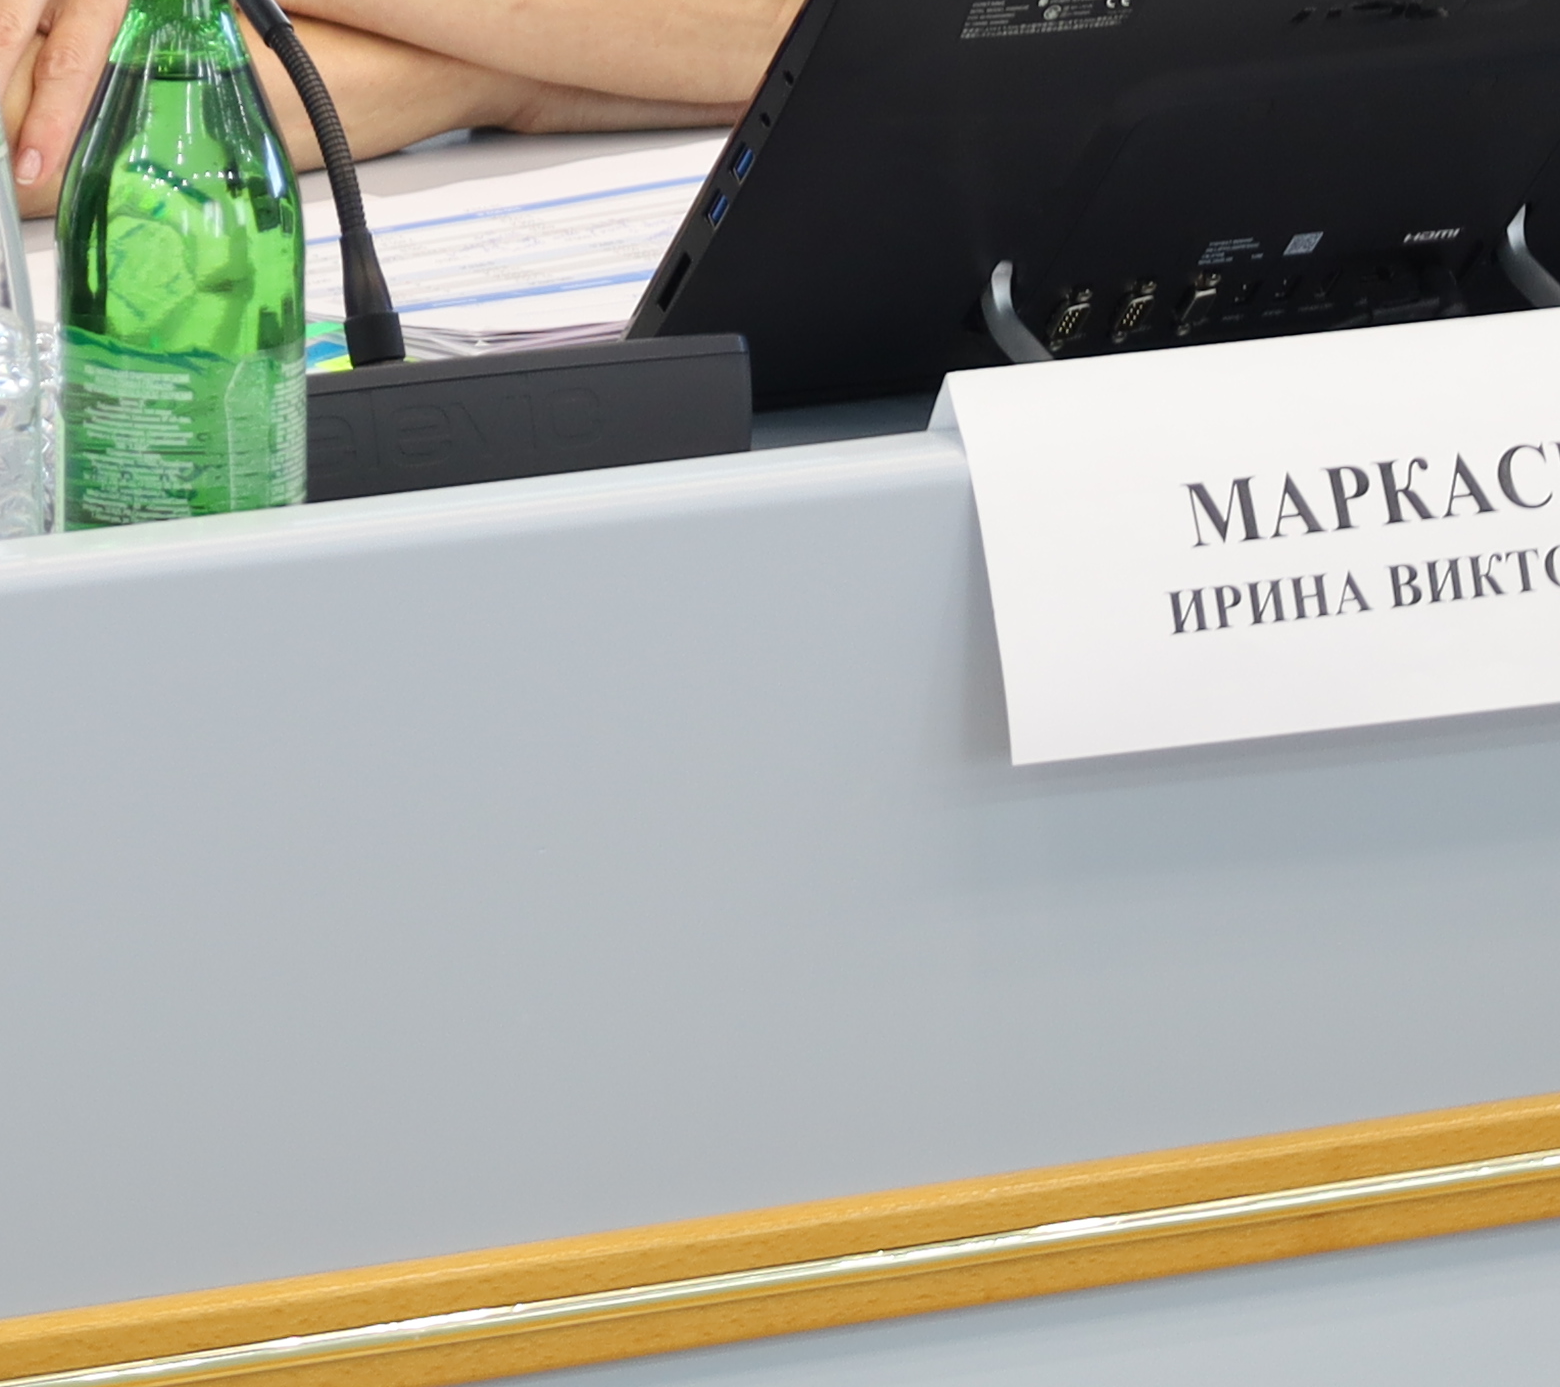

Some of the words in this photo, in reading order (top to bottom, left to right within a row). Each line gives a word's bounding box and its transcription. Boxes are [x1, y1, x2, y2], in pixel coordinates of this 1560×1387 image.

[1401, 227, 1462, 243] HDMI
[308, 377, 603, 472] elevic
[1166, 572, 1372, 637] ИРИНА
